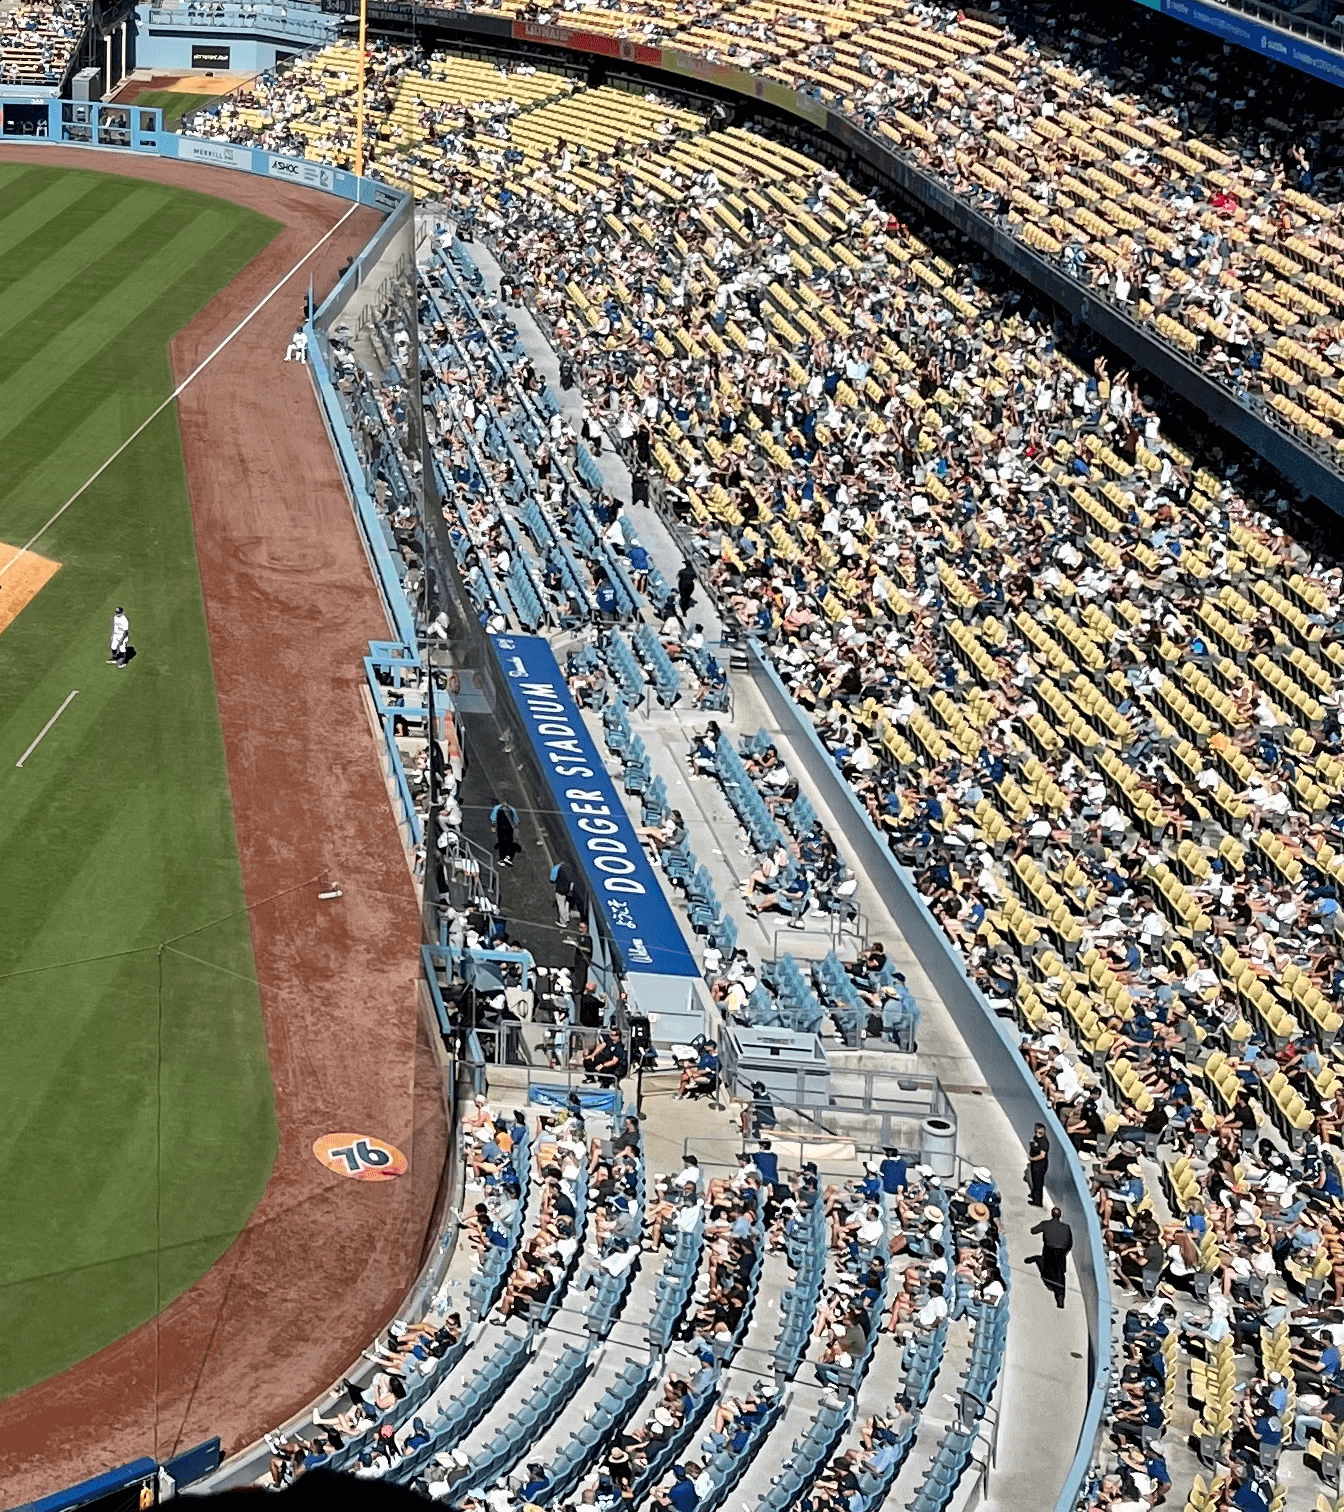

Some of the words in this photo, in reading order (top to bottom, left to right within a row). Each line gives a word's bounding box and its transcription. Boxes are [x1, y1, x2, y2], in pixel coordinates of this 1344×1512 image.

[193, 147, 223, 159] MERRILL
[518, 682, 595, 779] STADIUM
[565, 789, 646, 895] DODGER
[327, 1138, 395, 1176] 76
